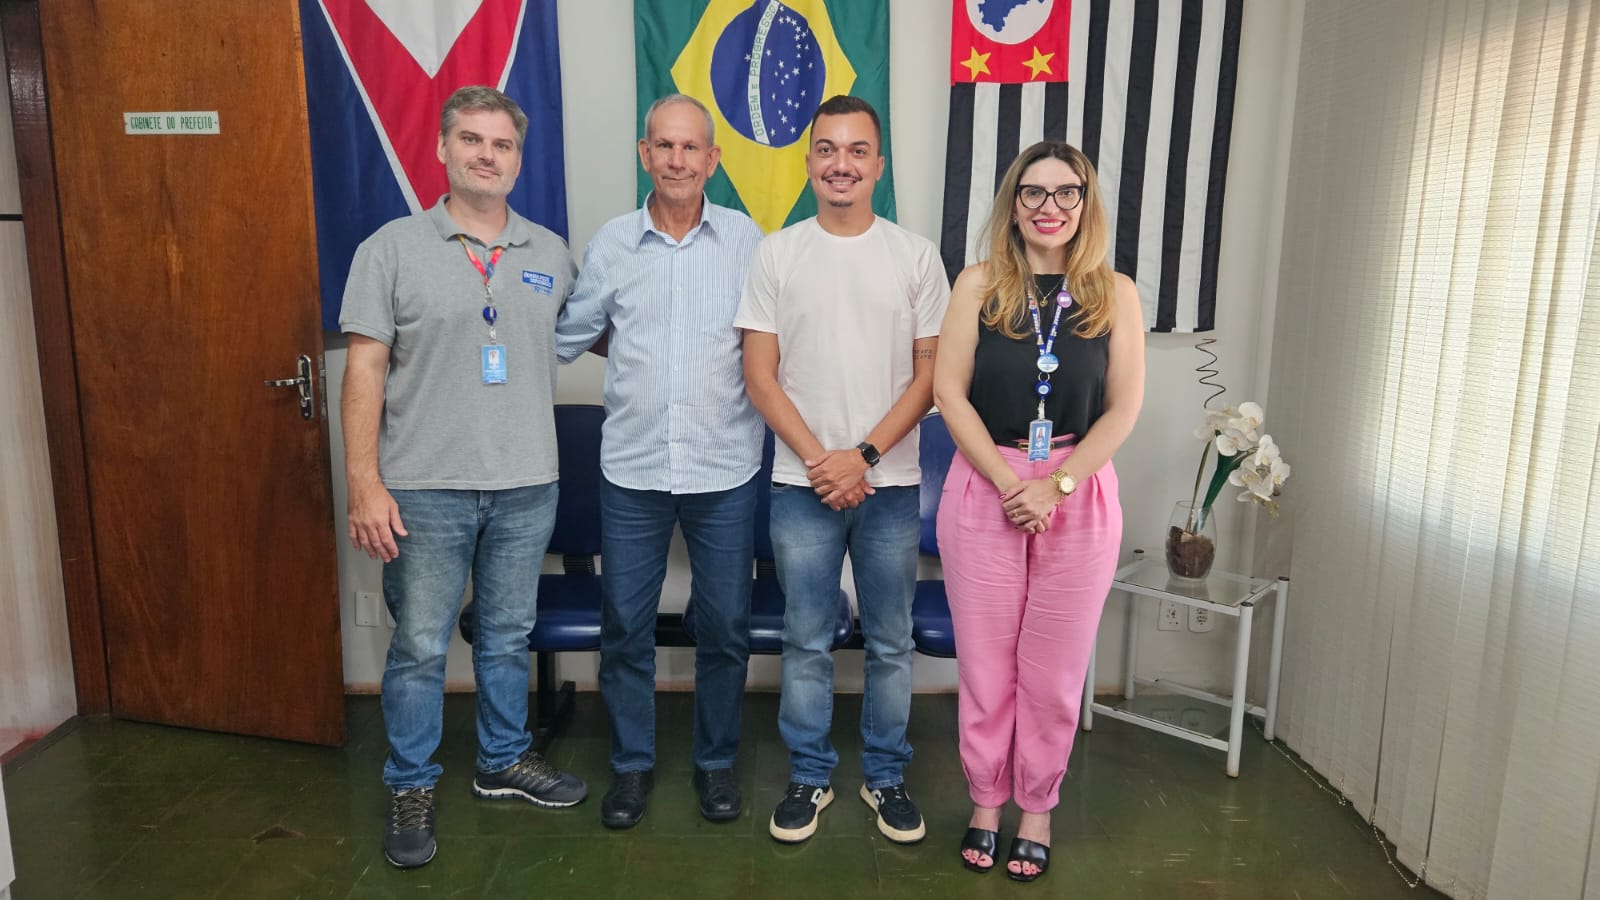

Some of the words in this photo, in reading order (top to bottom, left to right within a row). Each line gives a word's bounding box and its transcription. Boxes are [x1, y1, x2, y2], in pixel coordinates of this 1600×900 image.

[749, 4, 776, 77] PROGRESSO
[166, 116, 176, 130] DO
[180, 116, 213, 130] PREFEITO
[750, 95, 765, 137] ORDEM
